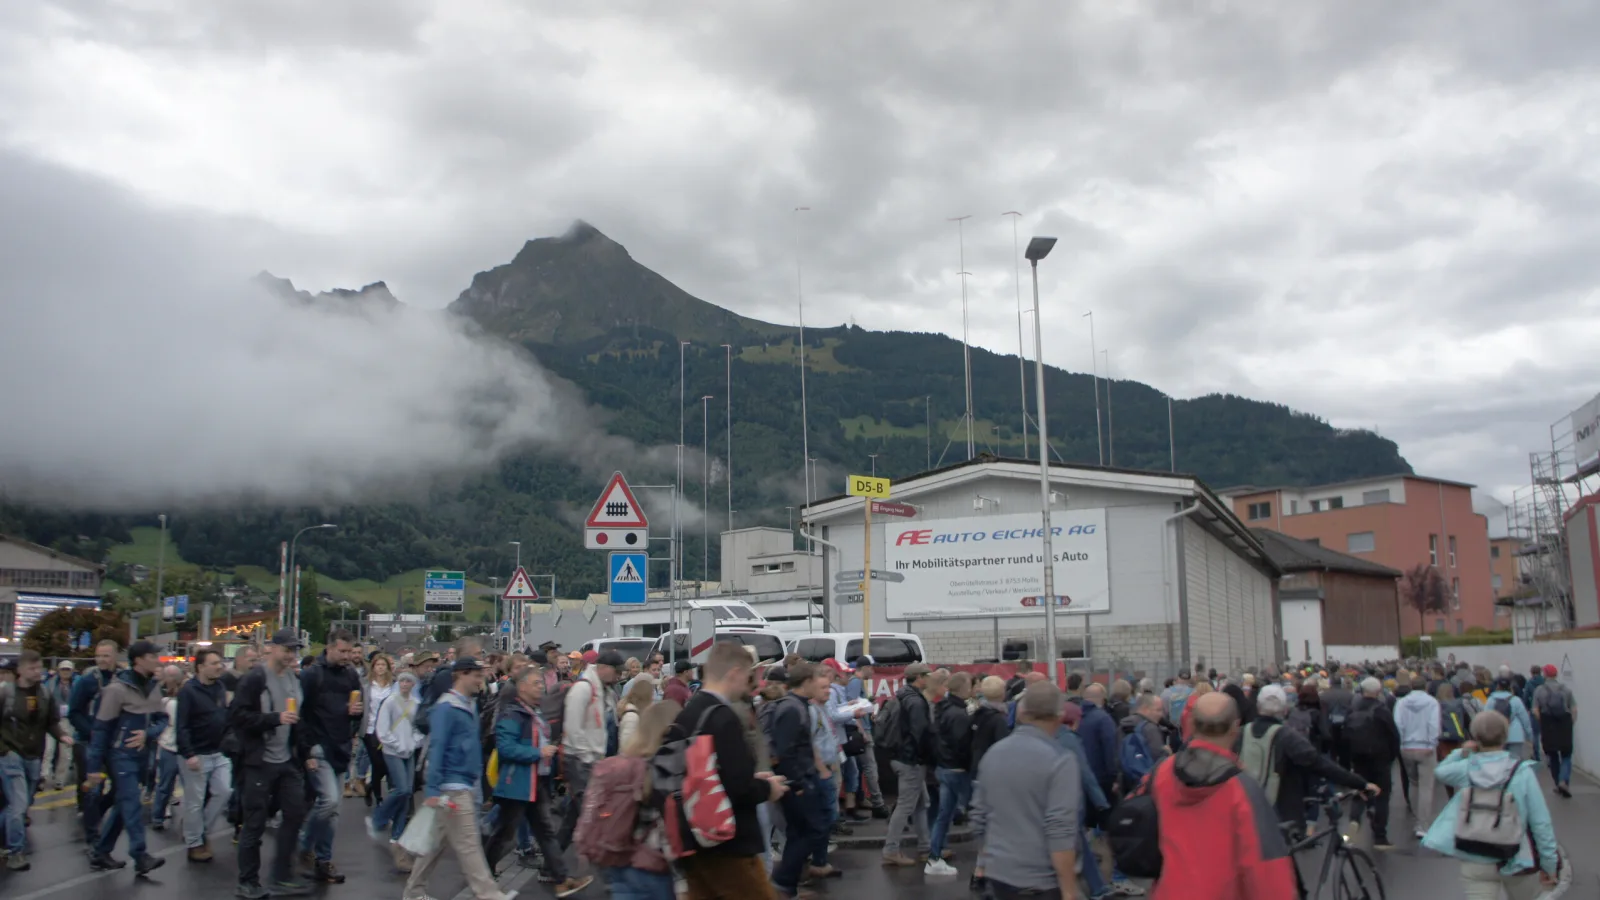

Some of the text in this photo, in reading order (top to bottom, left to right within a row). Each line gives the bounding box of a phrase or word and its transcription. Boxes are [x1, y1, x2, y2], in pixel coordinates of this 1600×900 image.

[856, 480, 883, 493] D5-B
[933, 525, 1096, 543] AUTO EICHER AG
[895, 551, 1089, 570] Ihr Mobilitätspartner rund us Auto
